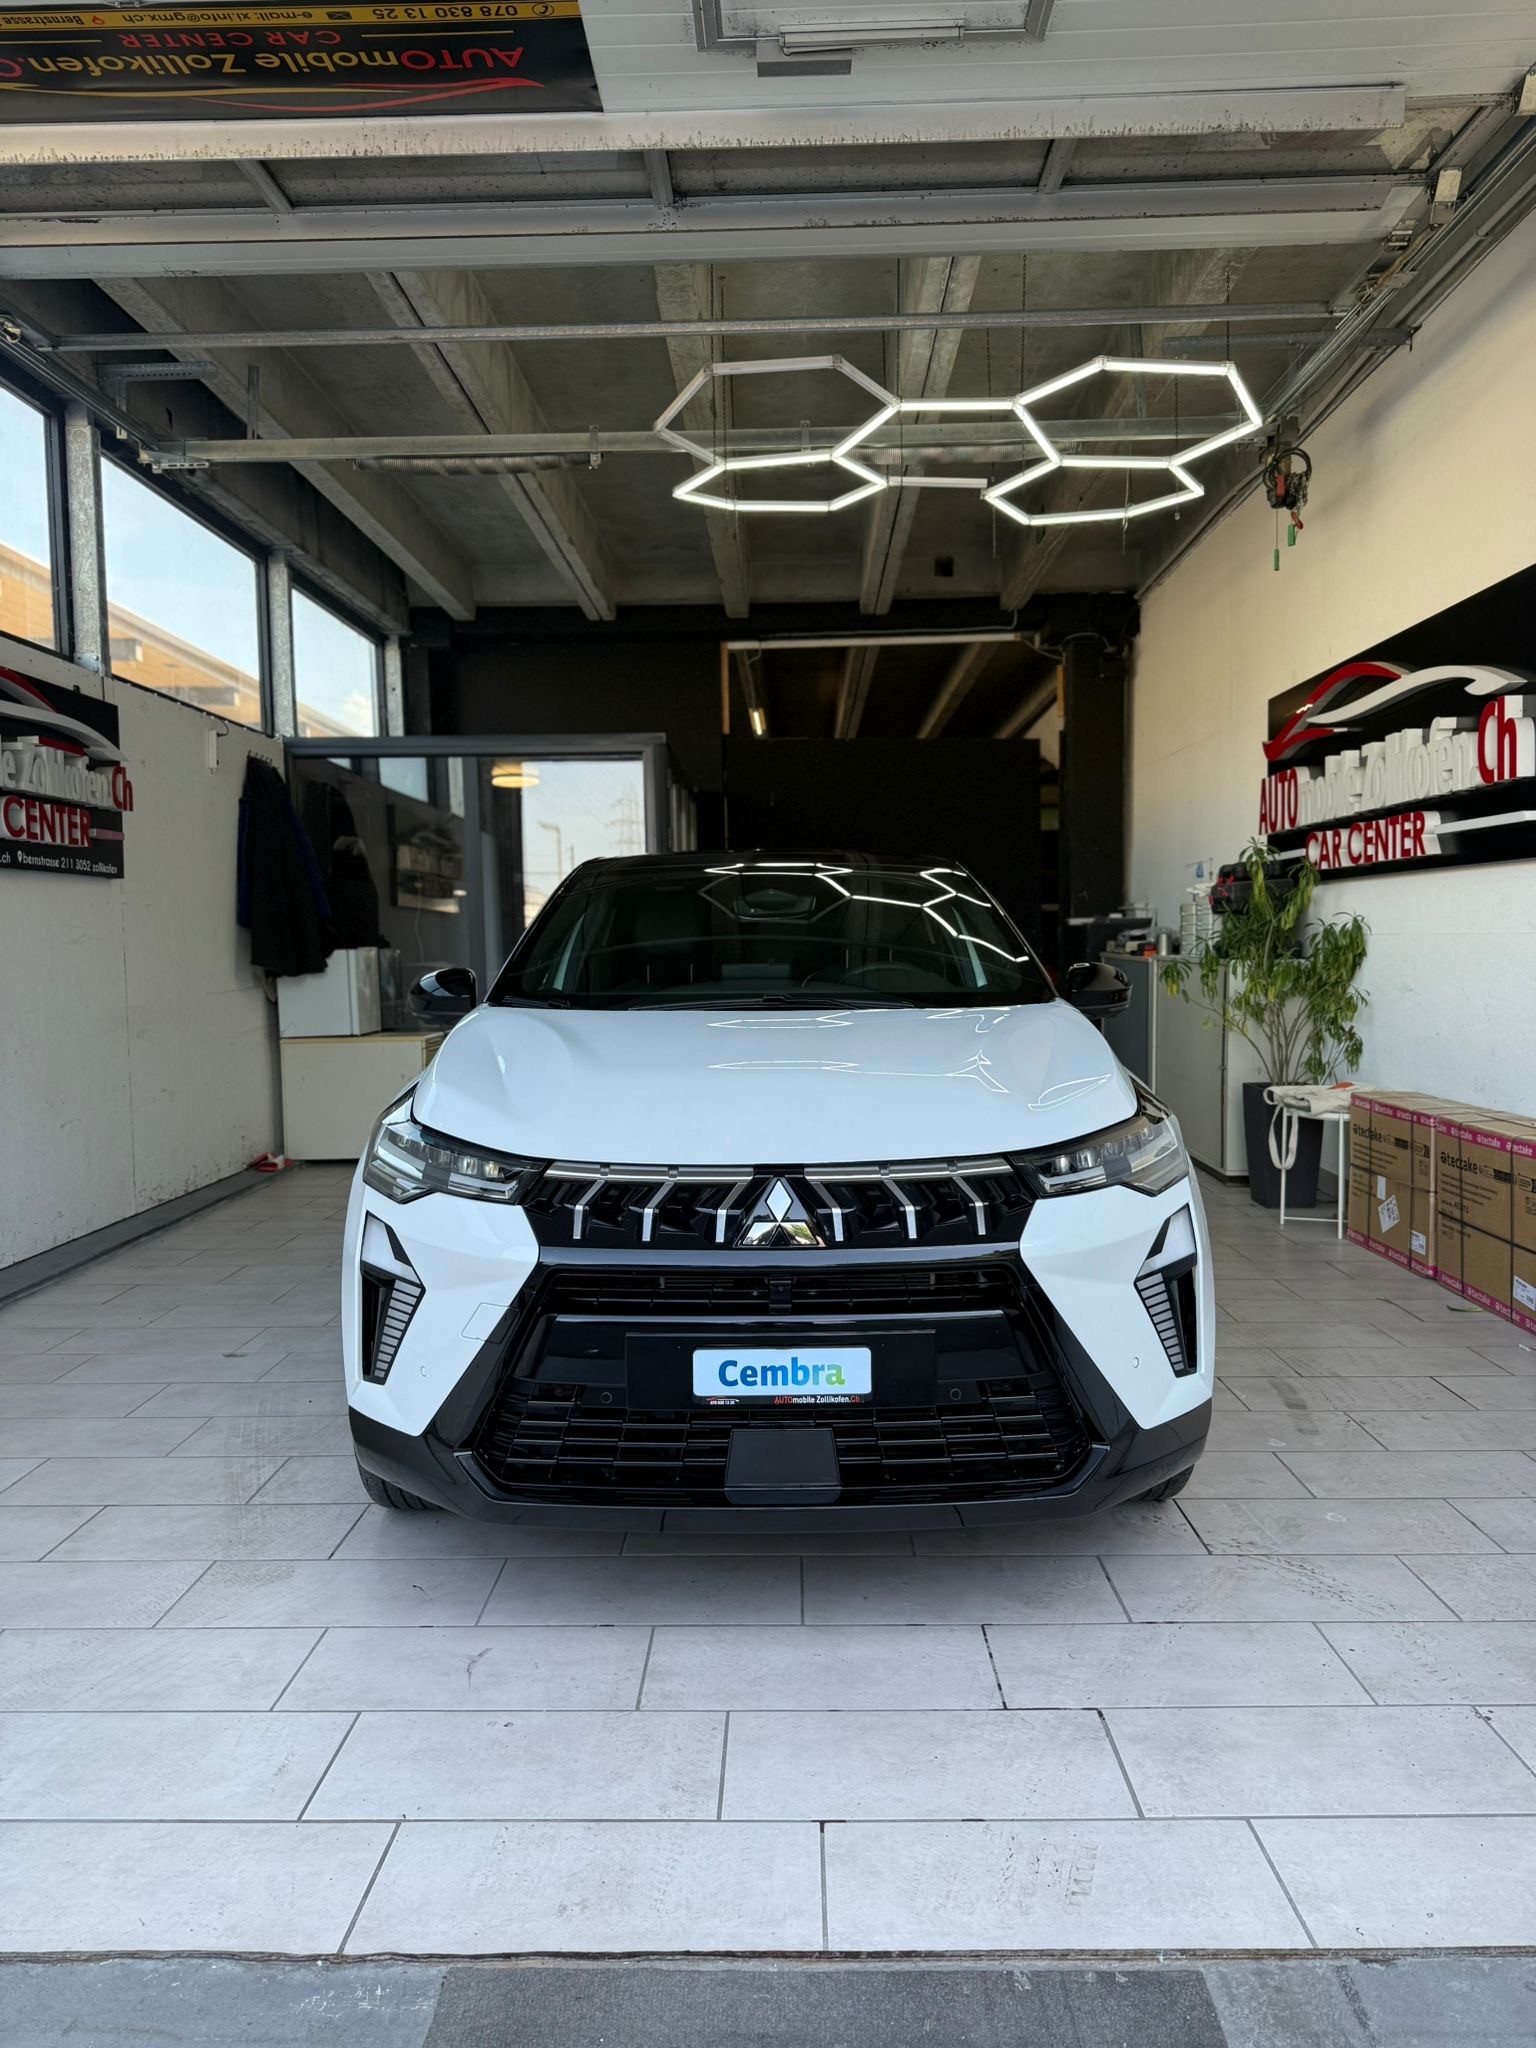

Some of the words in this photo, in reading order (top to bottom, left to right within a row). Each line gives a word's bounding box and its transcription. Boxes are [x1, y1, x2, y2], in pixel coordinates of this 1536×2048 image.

[256, 11, 313, 22] e-mail:
[372, 8, 399, 20] 25
[404, 7, 428, 19] 13
[434, 7, 473, 18] 830
[481, 5, 518, 17] 078
[118, 32, 254, 48] CENTER
[264, 30, 342, 46] CAR
[255, 47, 525, 73] AUTOmobile
[3, 795, 93, 848] CENTER
[1305, 828, 1343, 870] CAR
[1348, 811, 1426, 865] CENTER
[61, 857, 74, 869] 211
[76, 859, 91, 872] 3052
[718, 1356, 846, 1387] Cembra
[774, 1396, 815, 1404] AUTOmobile
